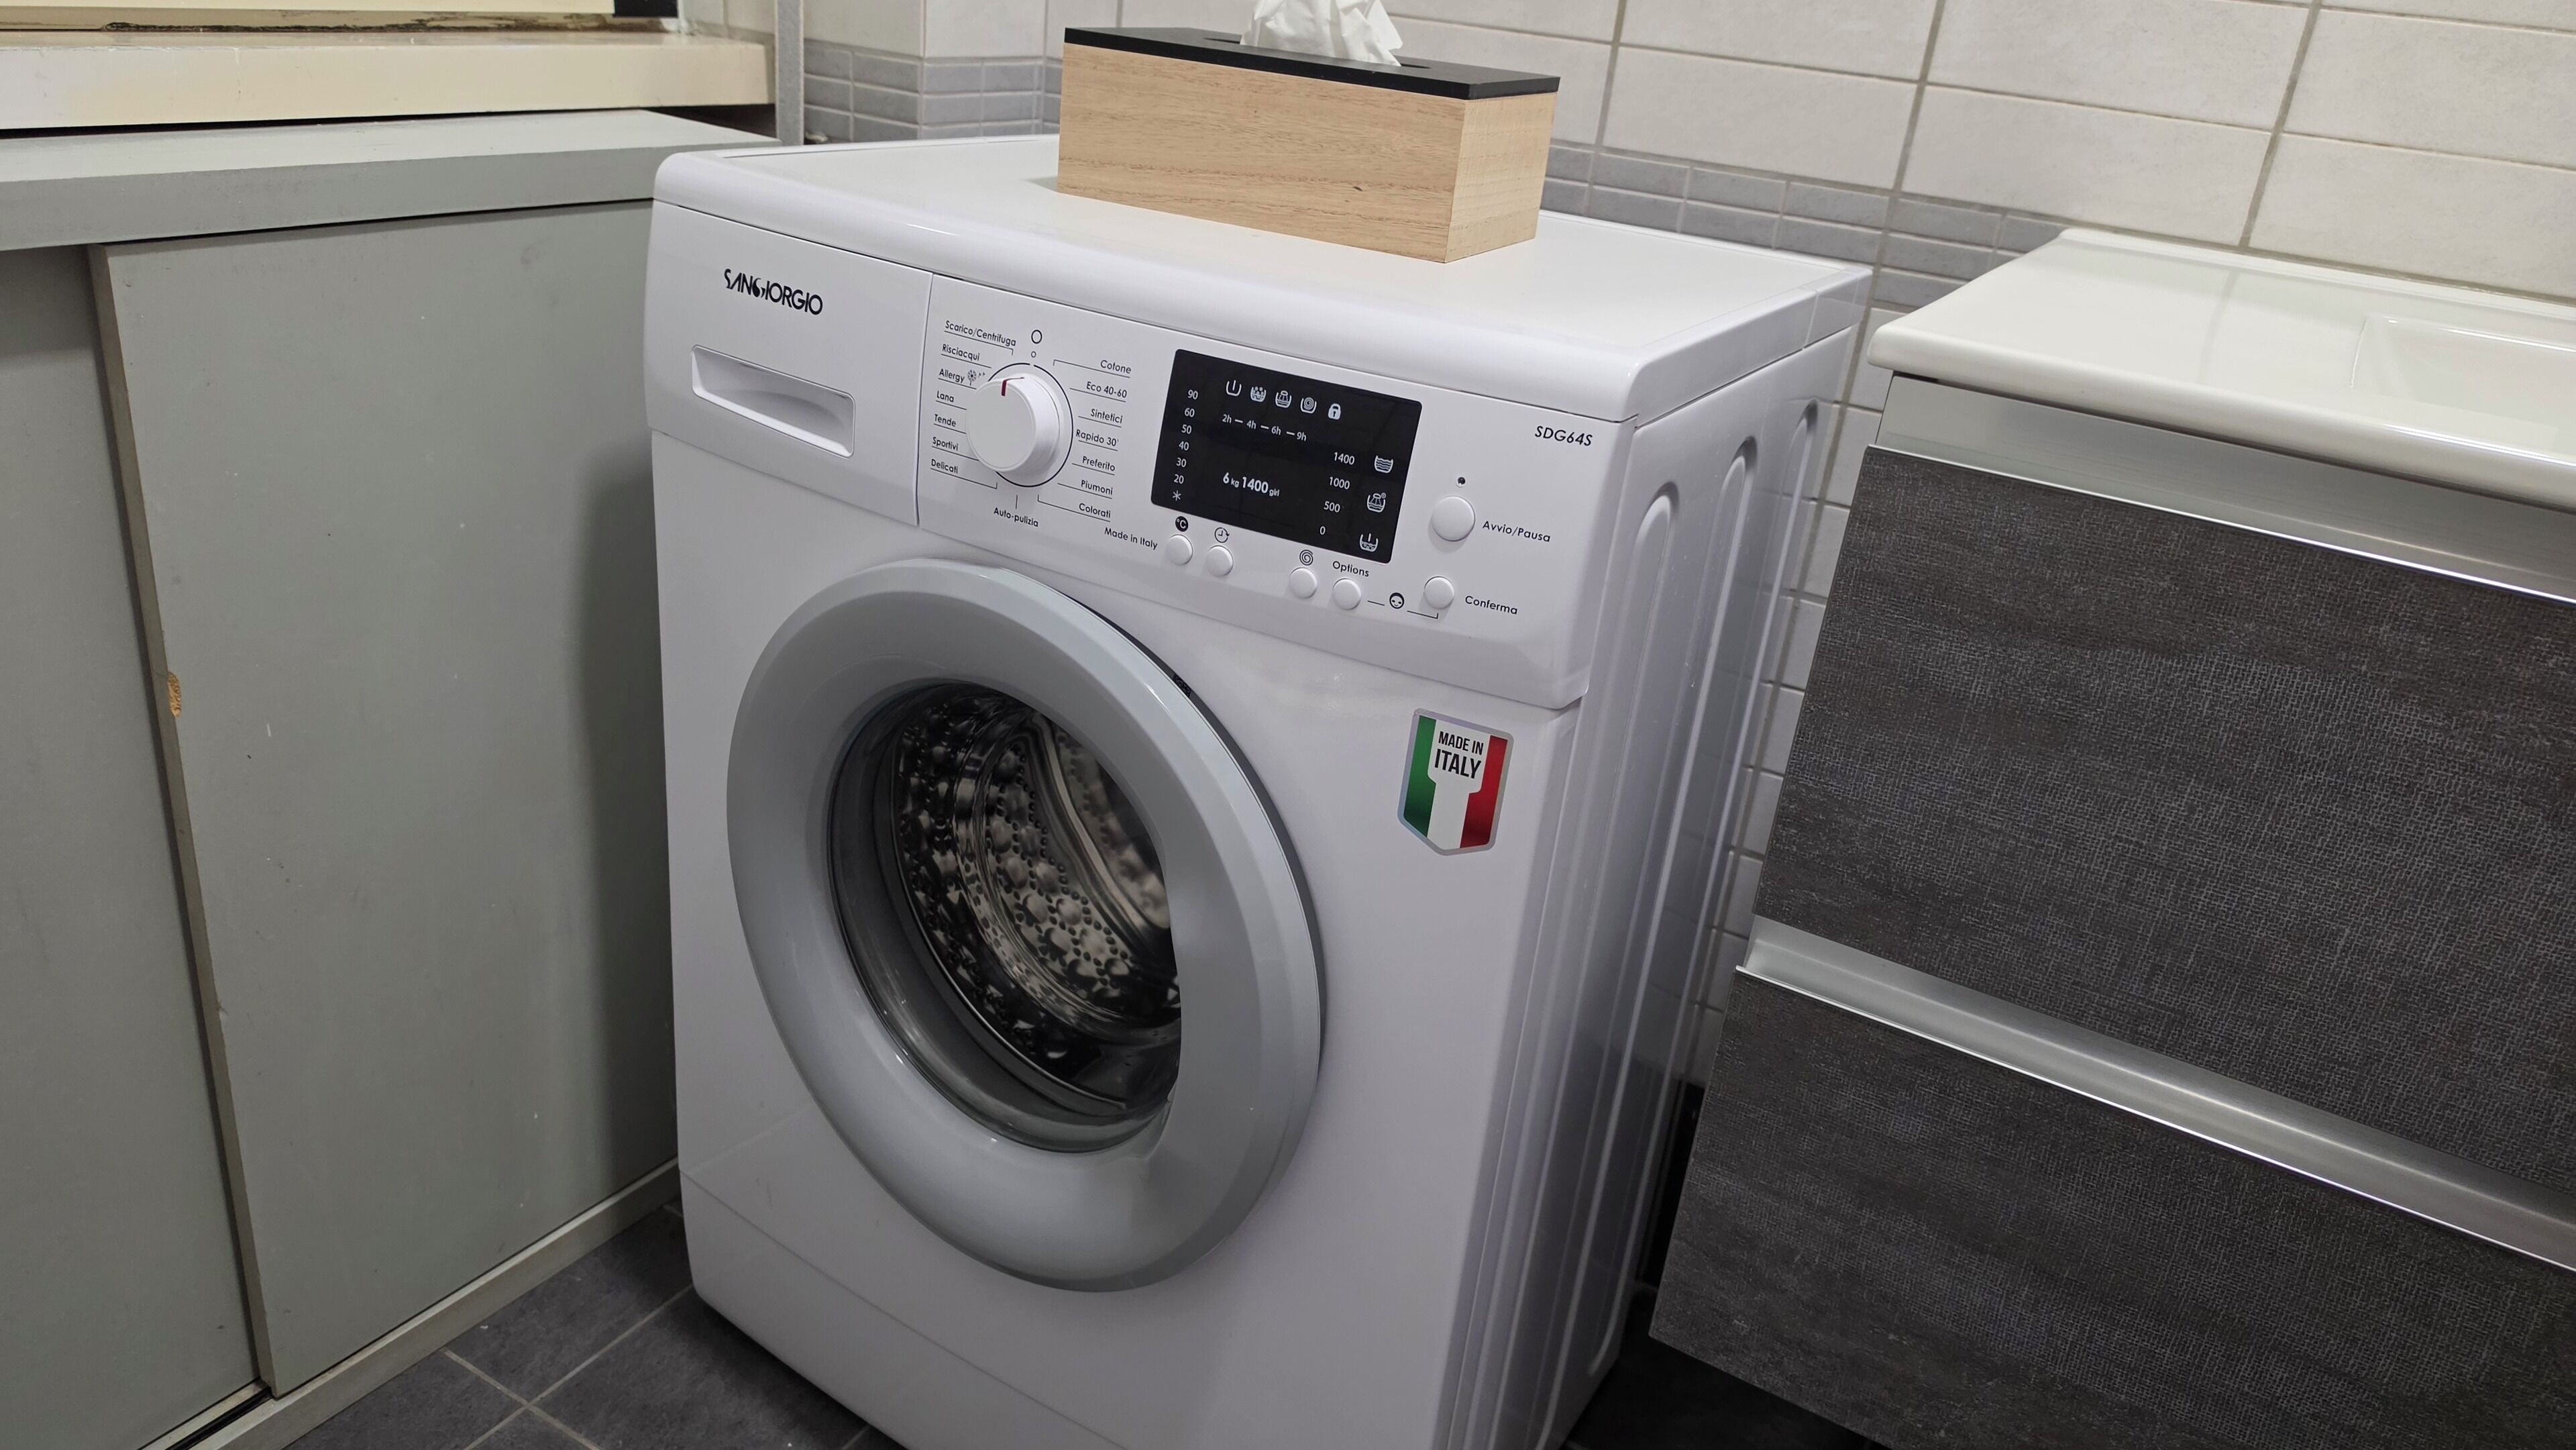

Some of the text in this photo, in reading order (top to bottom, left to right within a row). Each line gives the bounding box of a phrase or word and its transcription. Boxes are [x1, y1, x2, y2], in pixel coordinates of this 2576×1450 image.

[724, 268, 823, 315] SANGIORGIO
[945, 320, 1016, 347] Scarico/Centrifuga
[942, 344, 980, 362] Risciacqui
[1100, 360, 1132, 374] Cotone
[939, 368, 965, 383] Allergy
[936, 391, 955, 403] Lana
[1086, 381, 1127, 399] Eco 40-60
[1187, 389, 1198, 400] 90
[934, 413, 957, 427] Tende
[1091, 408, 1123, 424] Sintetici
[1184, 408, 1195, 417] 60
[1181, 424, 1192, 434] 50
[1222, 414, 1307, 442] 2h 4h 6h 9h
[1535, 425, 1593, 446] SDG64S
[932, 437, 959, 452] Sportivi
[1076, 429, 1104, 445] Rapido
[1179, 441, 1189, 451] 40
[931, 458, 959, 474] Delicati
[1082, 456, 1116, 472] Preferito
[1176, 458, 1187, 467] 30
[1333, 452, 1355, 465] 1400
[1174, 474, 1184, 484] 20
[1223, 472, 1230, 484] 6
[1231, 478, 1240, 488] kg
[1242, 476, 1269, 494] 1400
[1329, 476, 1350, 490] 1000
[1081, 480, 1113, 496] Piumoni
[1079, 503, 1111, 519] Colorati
[1324, 501, 1340, 513] 500
[994, 507, 1038, 527] Auto-pulizia
[1104, 527, 1158, 550] Made in Italy
[1320, 526, 1326, 535] 0
[1482, 521, 1551, 542] Avvio/Pausa
[1332, 560, 1369, 577] Options
[1465, 595, 1518, 615] Conferma
[1438, 731, 1484, 756] MADE IN
[1434, 748, 1482, 779] ITALY
